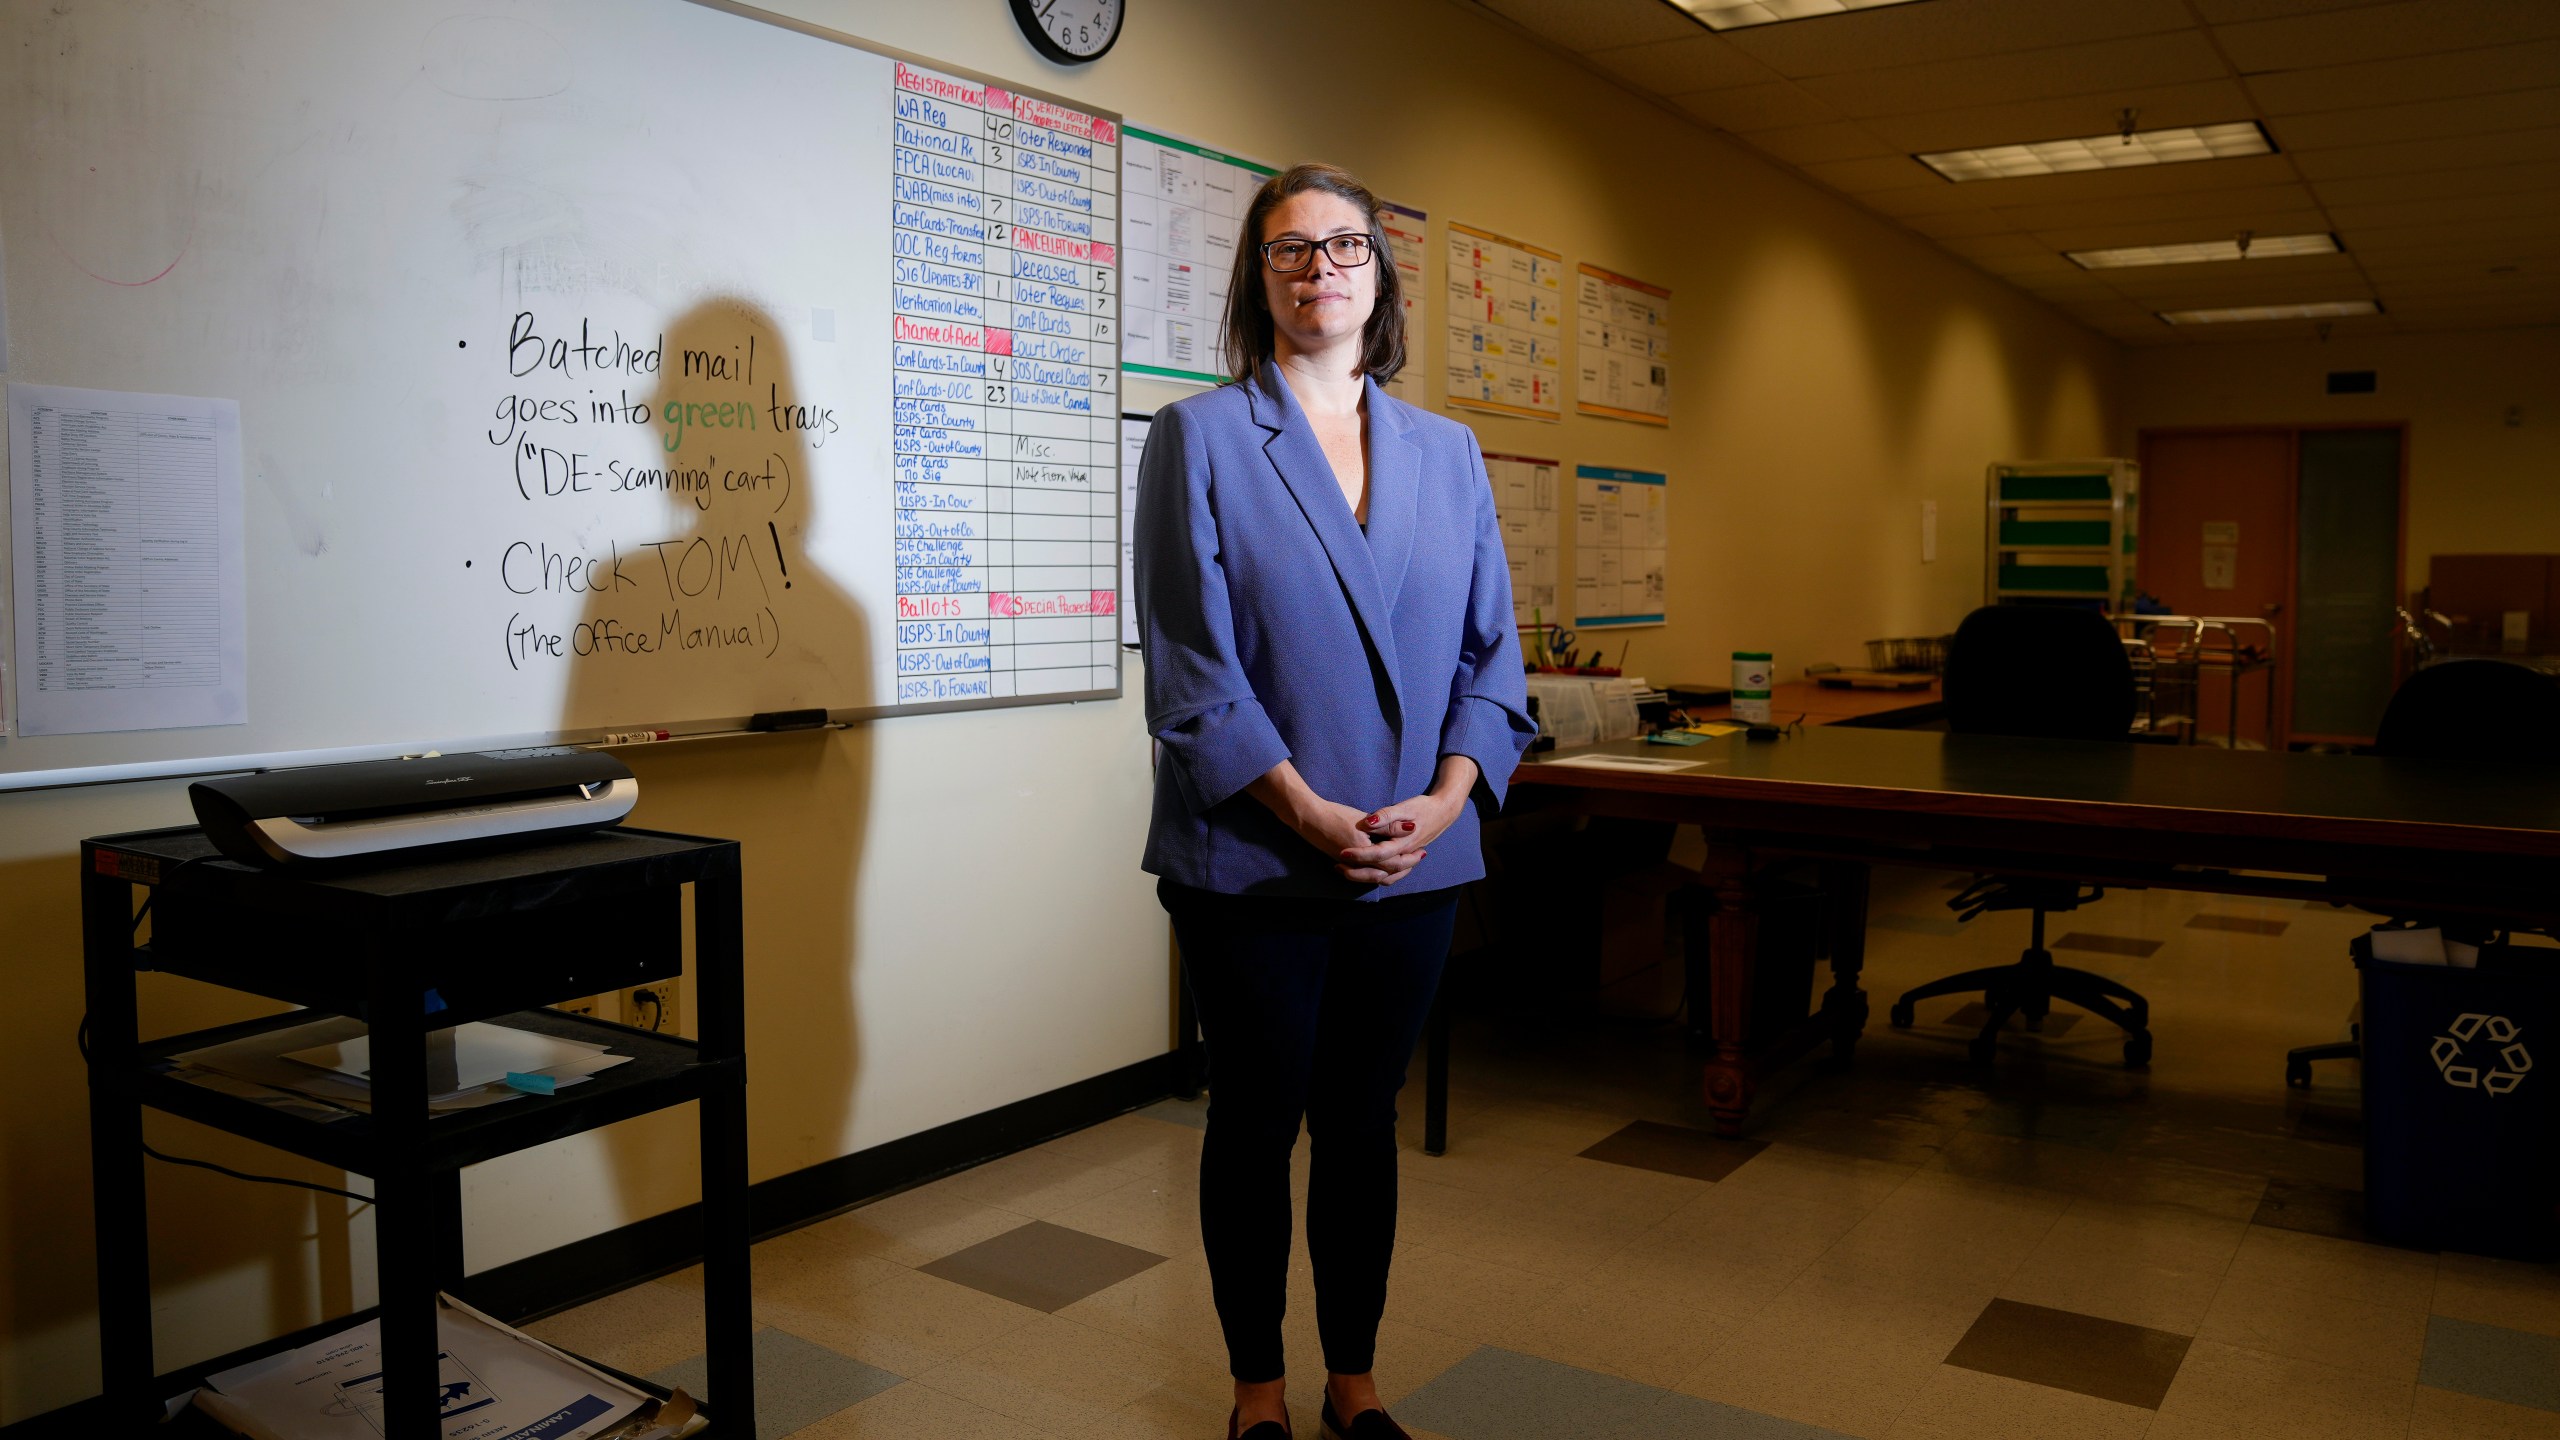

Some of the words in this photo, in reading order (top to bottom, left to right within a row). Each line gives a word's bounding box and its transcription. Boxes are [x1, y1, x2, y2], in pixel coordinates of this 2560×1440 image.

[1046, 13, 1055, 31] 7
[1092, 12, 1102, 29] 4
[1062, 27, 1072, 45] 6
[1079, 25, 1089, 43] 5
[897, 94, 919, 120] WA
[922, 100, 946, 128] Reg
[1013, 95, 1034, 121] GIS
[1036, 100, 1065, 117] VERIFY
[1066, 110, 1090, 126] VOTER
[986, 115, 1012, 141] 40
[1015, 126, 1046, 147] Voter
[961, 136, 977, 164] Re
[991, 146, 1003, 164] 3
[895, 148, 930, 176] FPCA
[1052, 159, 1081, 184] County
[957, 191, 981, 212] info)
[991, 199, 1003, 214] 7
[1058, 189, 1068, 204] of
[1068, 189, 1092, 212] County
[893, 202, 920, 228] Conf
[987, 224, 1006, 241] 12
[894, 232, 921, 256] OOC
[925, 236, 949, 266] Reg
[950, 244, 984, 265] forms
[1012, 226, 1090, 261] CANCELLATIONS
[1013, 251, 1080, 286] Deceased
[995, 279, 1001, 298] 1
[1096, 270, 1107, 293] 5
[894, 287, 952, 314] Verification
[1013, 281, 1047, 304] Voter
[1097, 298, 1106, 309] 7
[1012, 306, 1037, 331] Conf
[1038, 311, 1071, 335] Cards
[1095, 323, 1108, 337] 10
[942, 324, 955, 345] of
[509, 311, 663, 380] Batched
[683, 334, 756, 386] mail
[1011, 332, 1047, 358] Court
[1049, 340, 1086, 364] Order
[894, 345, 916, 368] Conf
[960, 355, 986, 378] County
[993, 357, 1005, 380] 4
[1011, 358, 1032, 380] SOS
[1033, 362, 1064, 385] Cancel
[1065, 367, 1091, 387] Cards
[1097, 373, 1108, 387] 7
[893, 375, 915, 396] Conf
[987, 385, 1006, 403] 23
[1012, 386, 1029, 404] Out
[1031, 388, 1040, 405] of
[894, 397, 918, 411] Conf
[919, 398, 946, 413] Cards
[488, 393, 579, 447] goes
[588, 388, 651, 425] into
[662, 398, 757, 453] green
[766, 381, 840, 449] trays
[941, 412, 975, 430] County
[895, 424, 918, 438] Conf
[919, 426, 948, 440] Cards
[945, 440, 955, 453] of
[954, 440, 982, 457] County
[1015, 434, 1056, 458] Misc.
[895, 453, 918, 469] Conf
[920, 455, 949, 469] Cards
[723, 451, 792, 514] cart)
[896, 481, 917, 494] VRC
[896, 509, 918, 522] VRC
[950, 522, 960, 537] of
[916, 539, 964, 556] Challenge
[501, 538, 638, 595] Check
[640, 520, 793, 604] TOM!
[938, 552, 973, 567] County
[916, 566, 963, 582] Challenge
[941, 579, 951, 593] of
[951, 579, 982, 594] County
[898, 596, 962, 617] Ballots
[571, 618, 654, 658] Office
[656, 606, 781, 660] Manual)
[954, 623, 990, 645] County
[953, 656, 963, 671] of
[962, 656, 991, 673] County
[505, 1410, 573, 1440] LAMINATI
